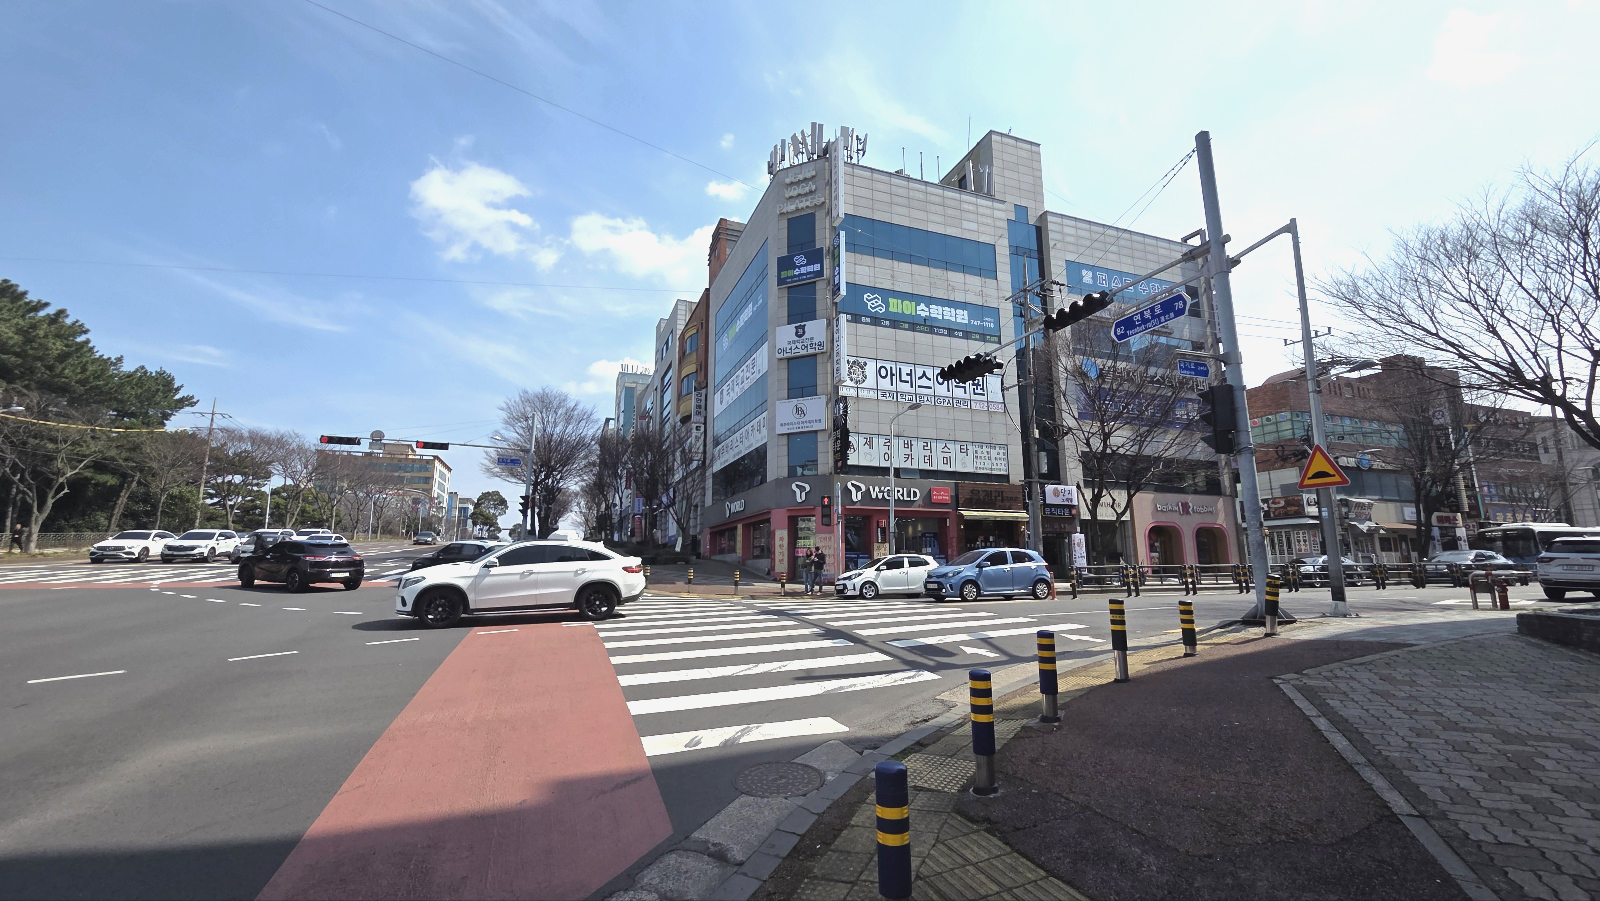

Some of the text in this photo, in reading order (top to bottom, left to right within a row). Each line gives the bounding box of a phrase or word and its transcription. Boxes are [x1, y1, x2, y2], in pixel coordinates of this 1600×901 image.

[784, 182, 816, 198] YOGA
[777, 194, 825, 214] PILATES
[889, 298, 968, 324] 파이수학학원
[1174, 301, 1184, 311] 78
[1133, 304, 1163, 325] 연북로
[1116, 326, 1125, 336] 82
[777, 340, 825, 356] 아너스어학원
[880, 392, 896, 401] 국제
[899, 393, 914, 402] 학교
[918, 396, 933, 405] 입시
[936, 397, 952, 406] GPA
[954, 399, 969, 408] 관리
[863, 437, 969, 456] 제주바리스타
[869, 485, 921, 501] WORLD
[730, 499, 745, 514] WORLD
[1044, 507, 1070, 516] 뮤직타운
